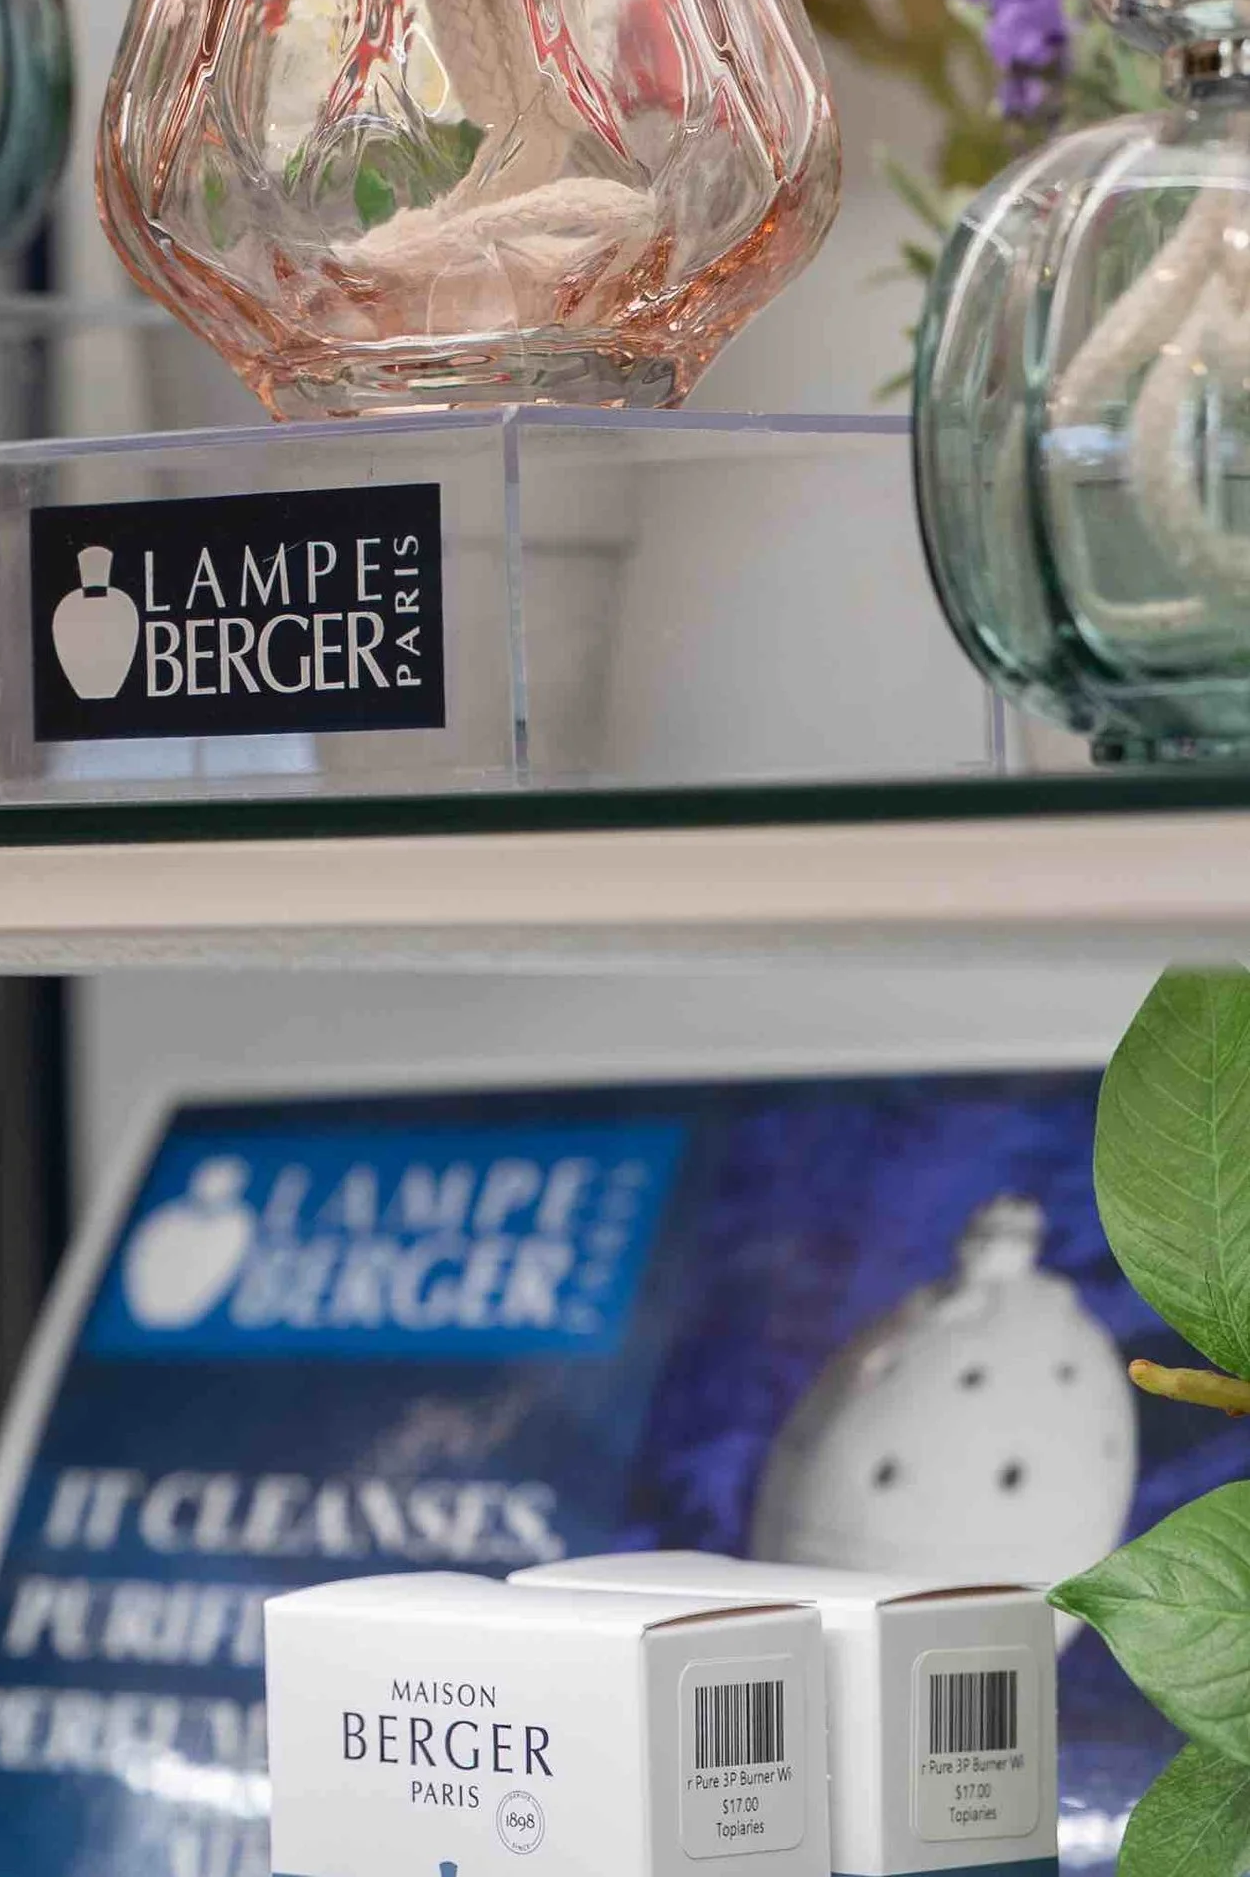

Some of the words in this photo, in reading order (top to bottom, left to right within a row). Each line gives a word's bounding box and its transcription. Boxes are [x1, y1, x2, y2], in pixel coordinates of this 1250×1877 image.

[144, 537, 383, 612] LAMPE
[394, 534, 423, 687] PARIS
[145, 611, 391, 697] BERGER
[391, 1679, 496, 1708] MAISON
[342, 1711, 554, 1777] BERGER
[930, 1760, 952, 1774] Pure
[695, 1775, 719, 1790] Pure
[723, 1771, 737, 1787] 3P
[740, 1770, 775, 1786] Burner
[411, 1780, 480, 1809] PARIS
[955, 1783, 991, 1800] $17.00
[722, 1796, 759, 1814] $17.00
[949, 1805, 997, 1826] Topiaries
[505, 1811, 535, 1832] 1898
[715, 1819, 765, 1840] Topiaries
